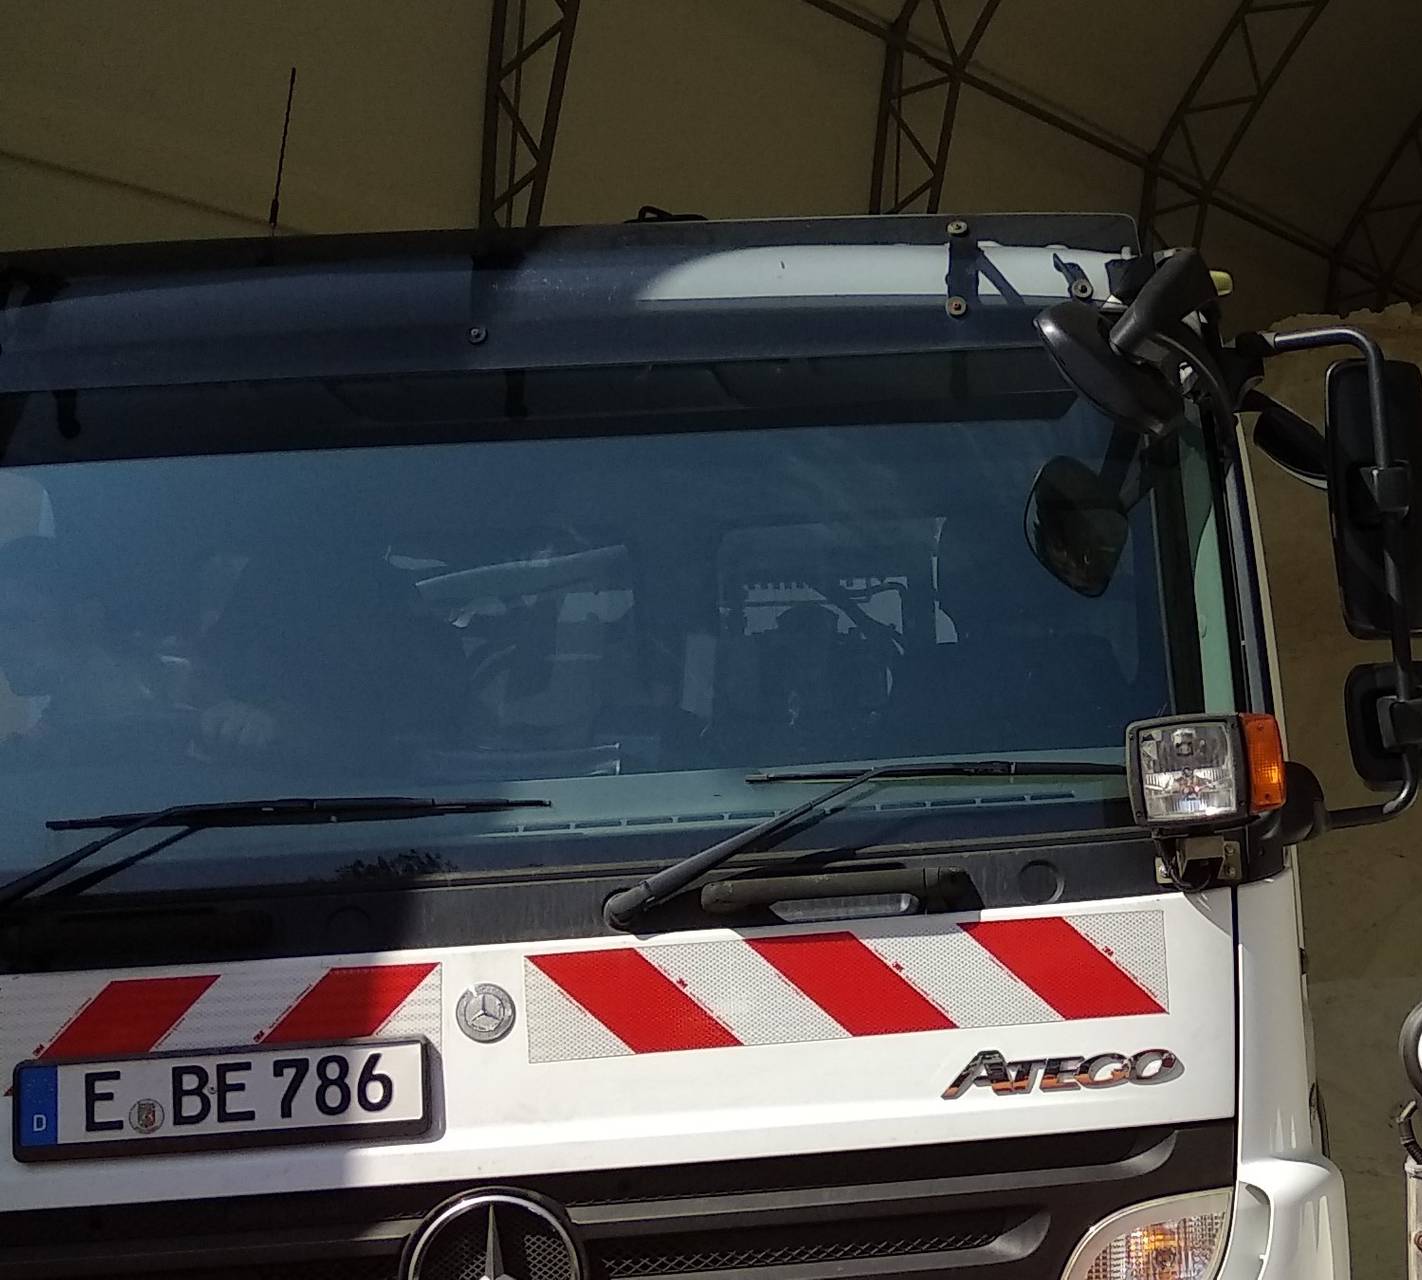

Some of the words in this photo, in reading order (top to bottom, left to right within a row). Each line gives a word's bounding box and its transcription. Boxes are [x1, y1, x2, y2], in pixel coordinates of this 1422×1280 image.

[84, 1070, 124, 1132] E
[171, 1061, 255, 1126] BE
[272, 1052, 394, 1119] 786
[32, 1113, 47, 1132] D
